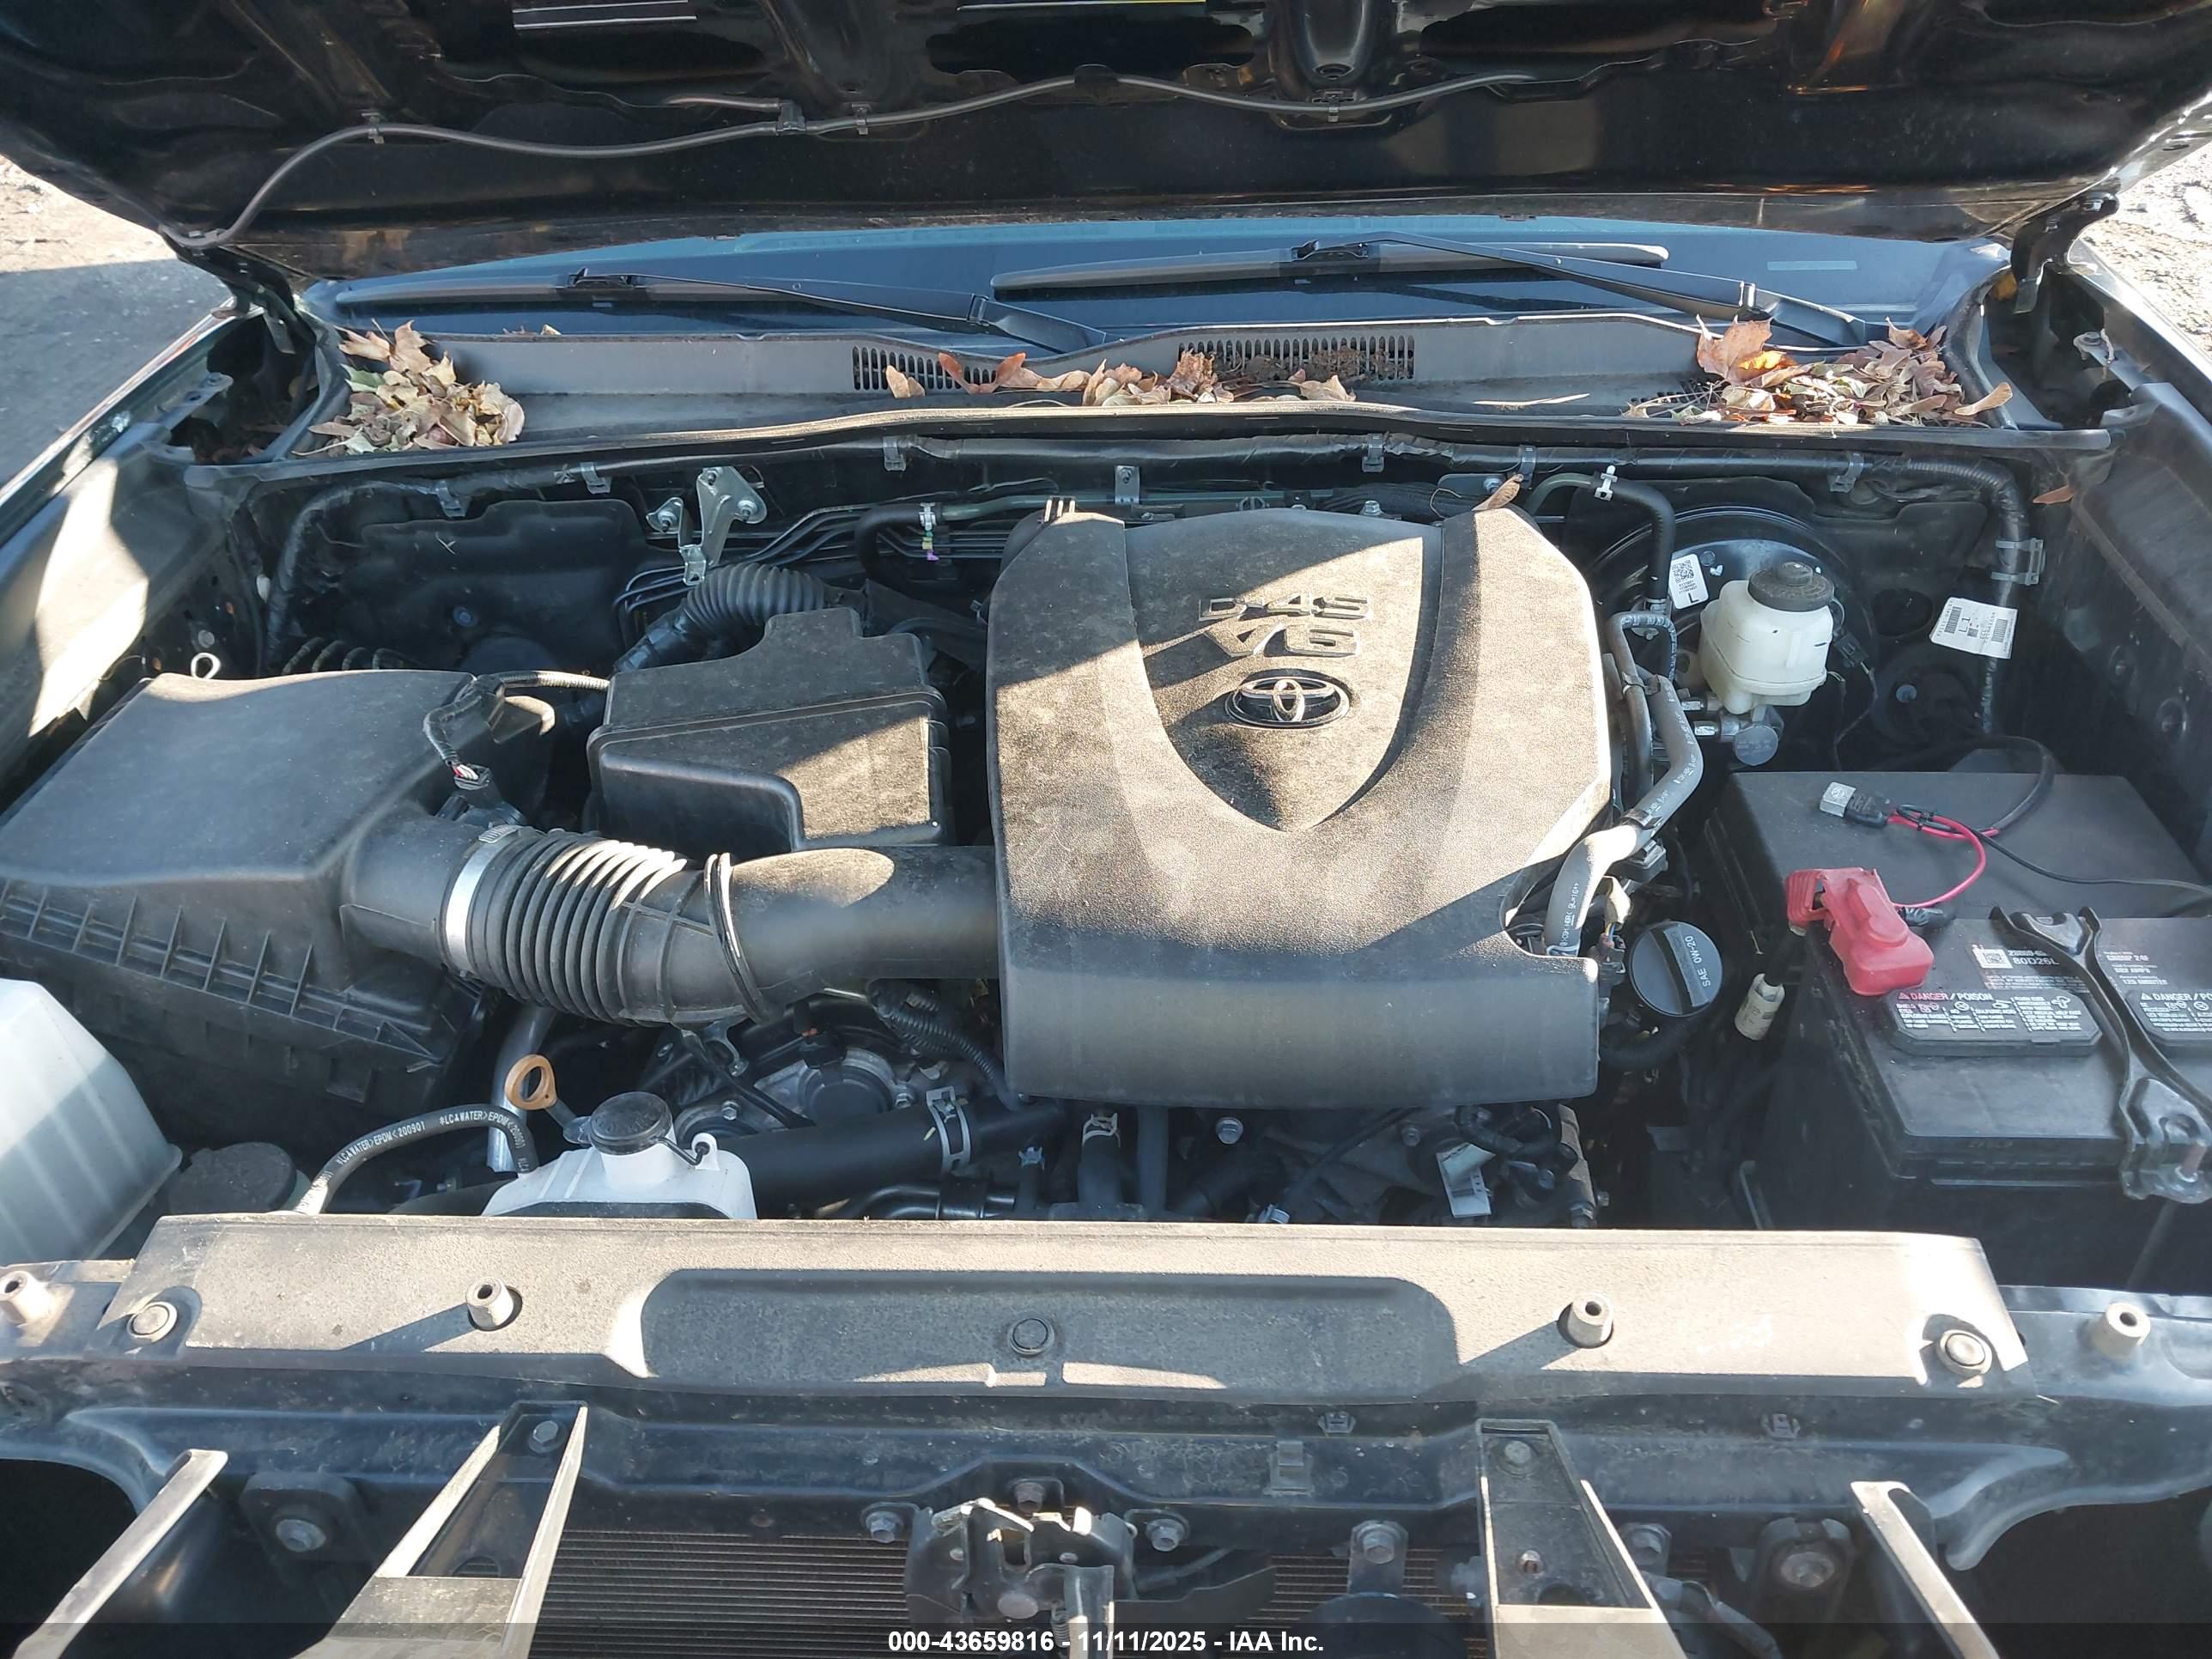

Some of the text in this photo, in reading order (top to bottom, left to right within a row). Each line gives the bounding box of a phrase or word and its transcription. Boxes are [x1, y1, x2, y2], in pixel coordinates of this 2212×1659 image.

[1688, 592, 1700, 604] L
[1202, 623, 1362, 658] V6
[1685, 935, 1711, 988] SAE 0W-20
[1956, 993, 1994, 1001] POISON
[2152, 993, 2193, 1001] DANGER
